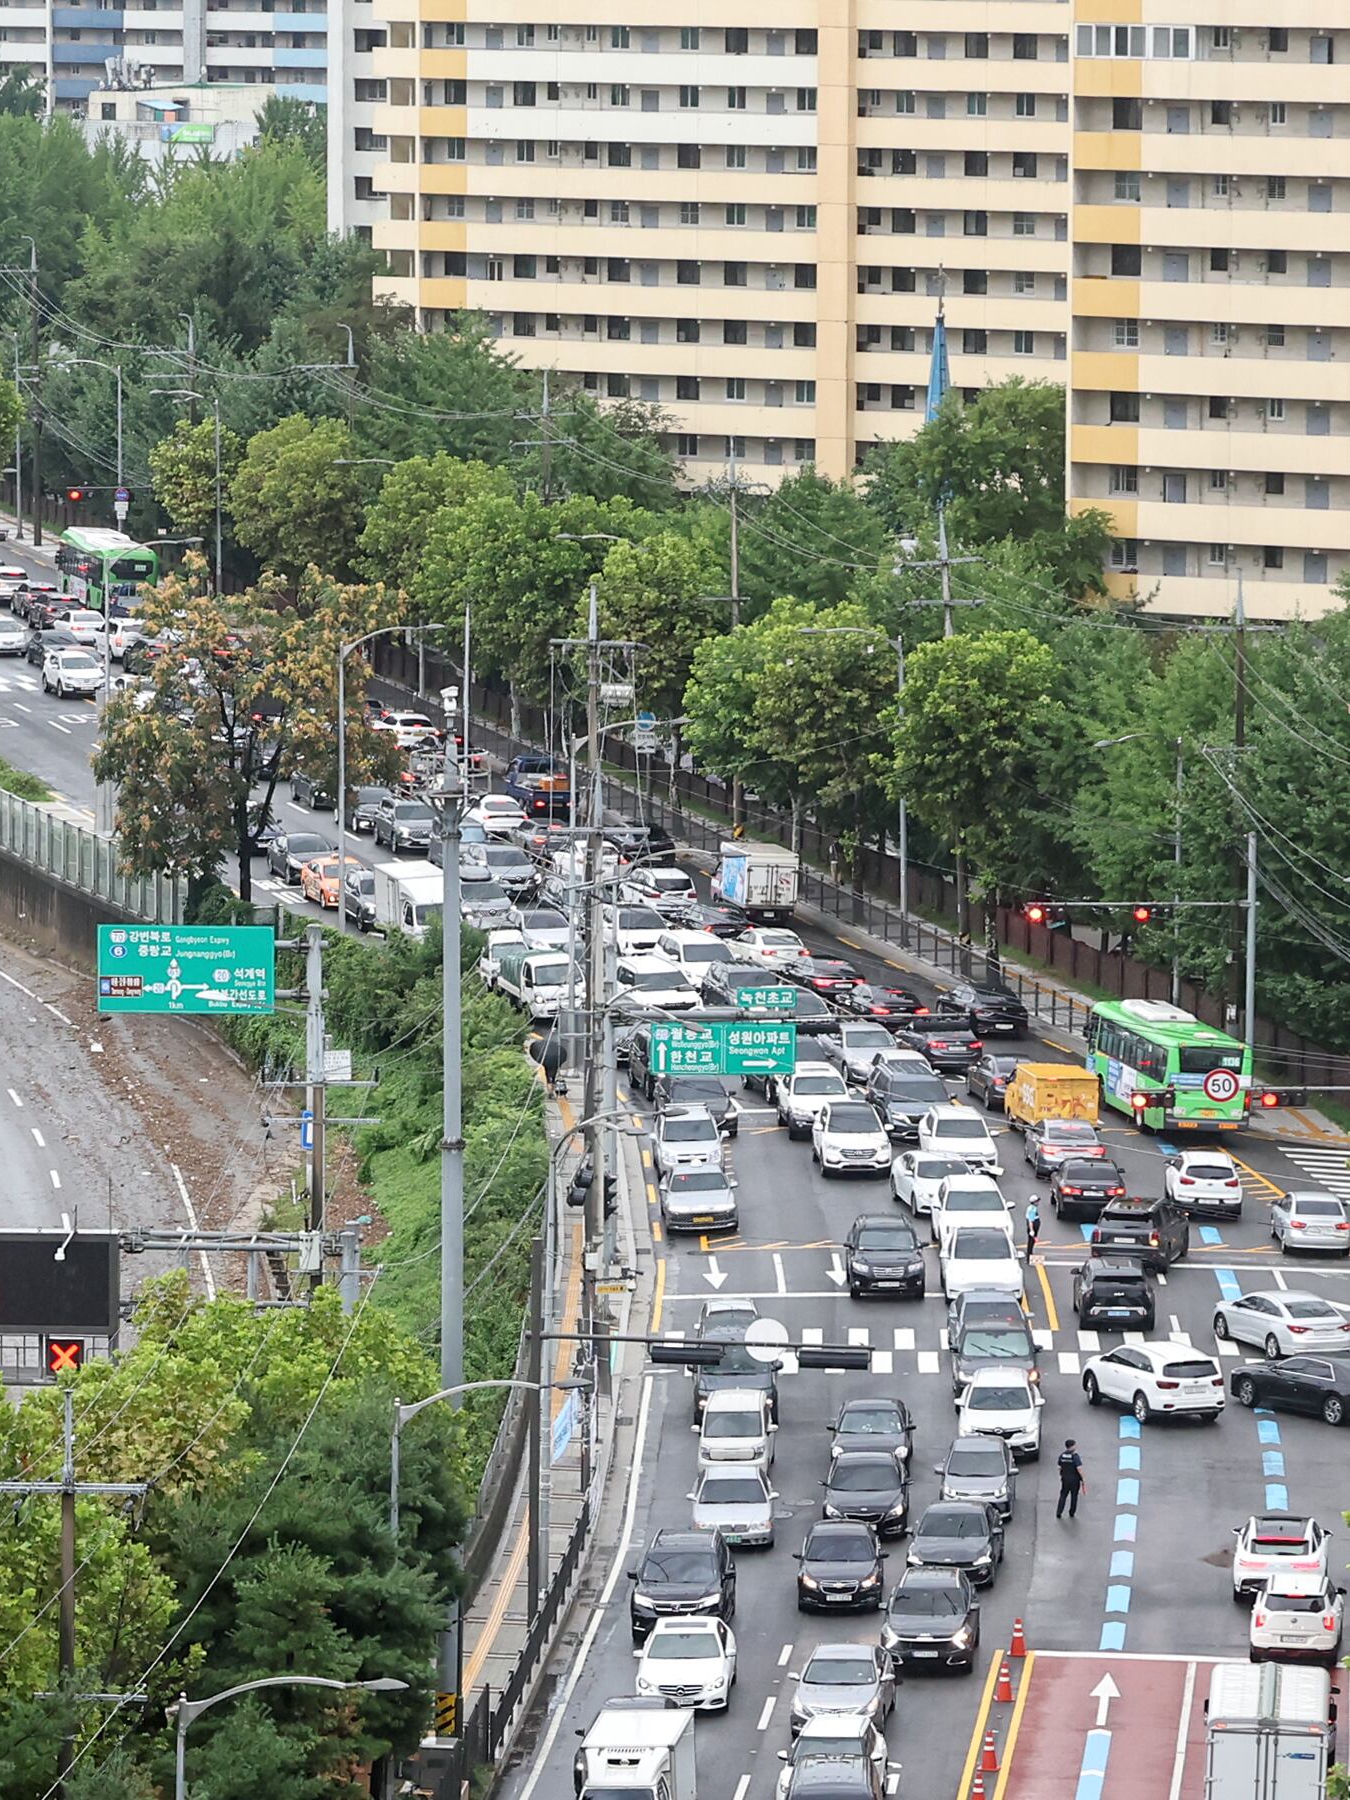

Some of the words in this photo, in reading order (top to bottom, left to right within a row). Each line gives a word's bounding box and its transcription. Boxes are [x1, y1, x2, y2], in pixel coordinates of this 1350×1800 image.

[129, 931, 172, 942] 강변북로
[175, 935, 208, 945] Gangbyeon
[210, 935, 230, 945] Expwy
[113, 946, 123, 956] 6
[138, 944, 172, 957] 중랑교
[217, 970, 227, 980] 20
[234, 968, 266, 979] 석계역
[740, 992, 793, 1005] 녹천초교
[168, 1001, 184, 1009] 1km
[728, 1031, 791, 1046] 성원아파트
[671, 1050, 713, 1063] 한천교
[728, 1046, 769, 1057] Seongwon
[771, 1046, 785, 1056] Apt
[1211, 1078, 1232, 1093] 50
